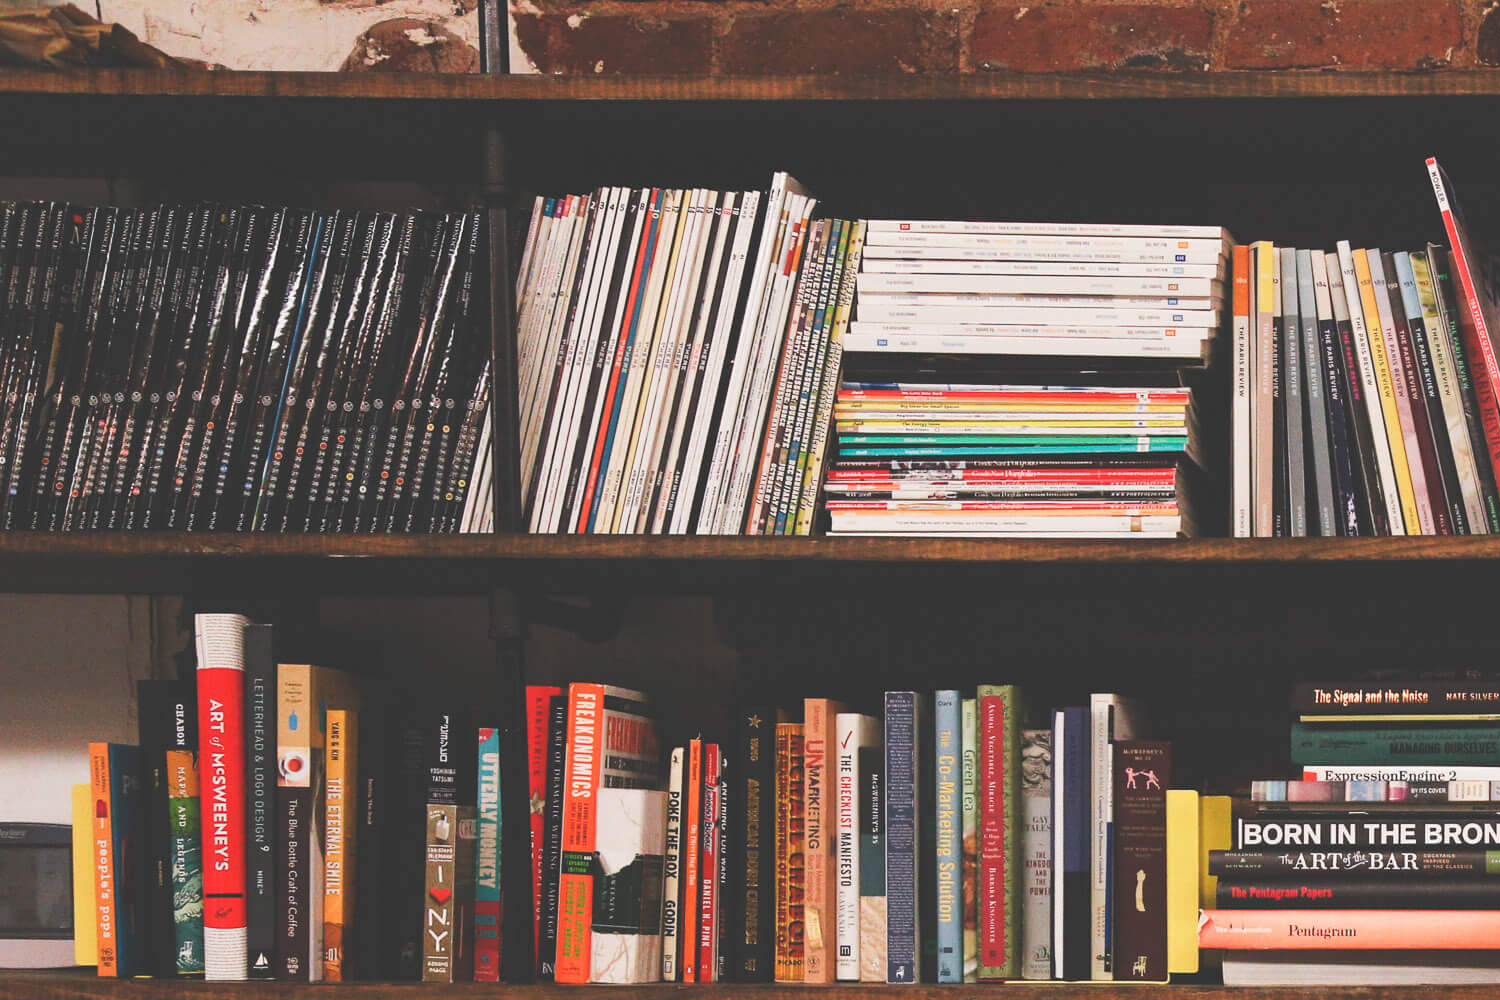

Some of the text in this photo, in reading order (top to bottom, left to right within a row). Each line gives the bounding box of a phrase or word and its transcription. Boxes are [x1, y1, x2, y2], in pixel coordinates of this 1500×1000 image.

[1432, 172, 1445, 202] HOWLER
[1313, 690, 1429, 706] The Signal and the Noise
[1446, 692, 1500, 701] NATE SILVER
[571, 692, 596, 799] FREAKONOMICS
[1389, 742, 1498, 754] MANAGING OURSELVES
[209, 699, 229, 871] ART of McSWEENEY'S
[1325, 770, 1457, 781] ExpressionEngine 2
[937, 755, 956, 856] Co-Marketing
[1032, 816, 1049, 825] GAY
[664, 791, 680, 879] POKE THE BOX
[840, 755, 852, 887] THE CHECKLIST MANIFESTO
[1244, 823, 1321, 845] BORN
[1330, 823, 1358, 845] IN
[1364, 823, 1416, 845] THE
[326, 779, 340, 895] THE ETERNAL SMILE
[1292, 852, 1341, 870] ART
[1369, 853, 1419, 870] BAR
[97, 840, 111, 938] people's pops
[938, 863, 955, 922] Solution
[1231, 886, 1333, 900] The Pentagram Papers
[663, 900, 676, 937] GODIN
[1288, 925, 1357, 939] Pentagram
